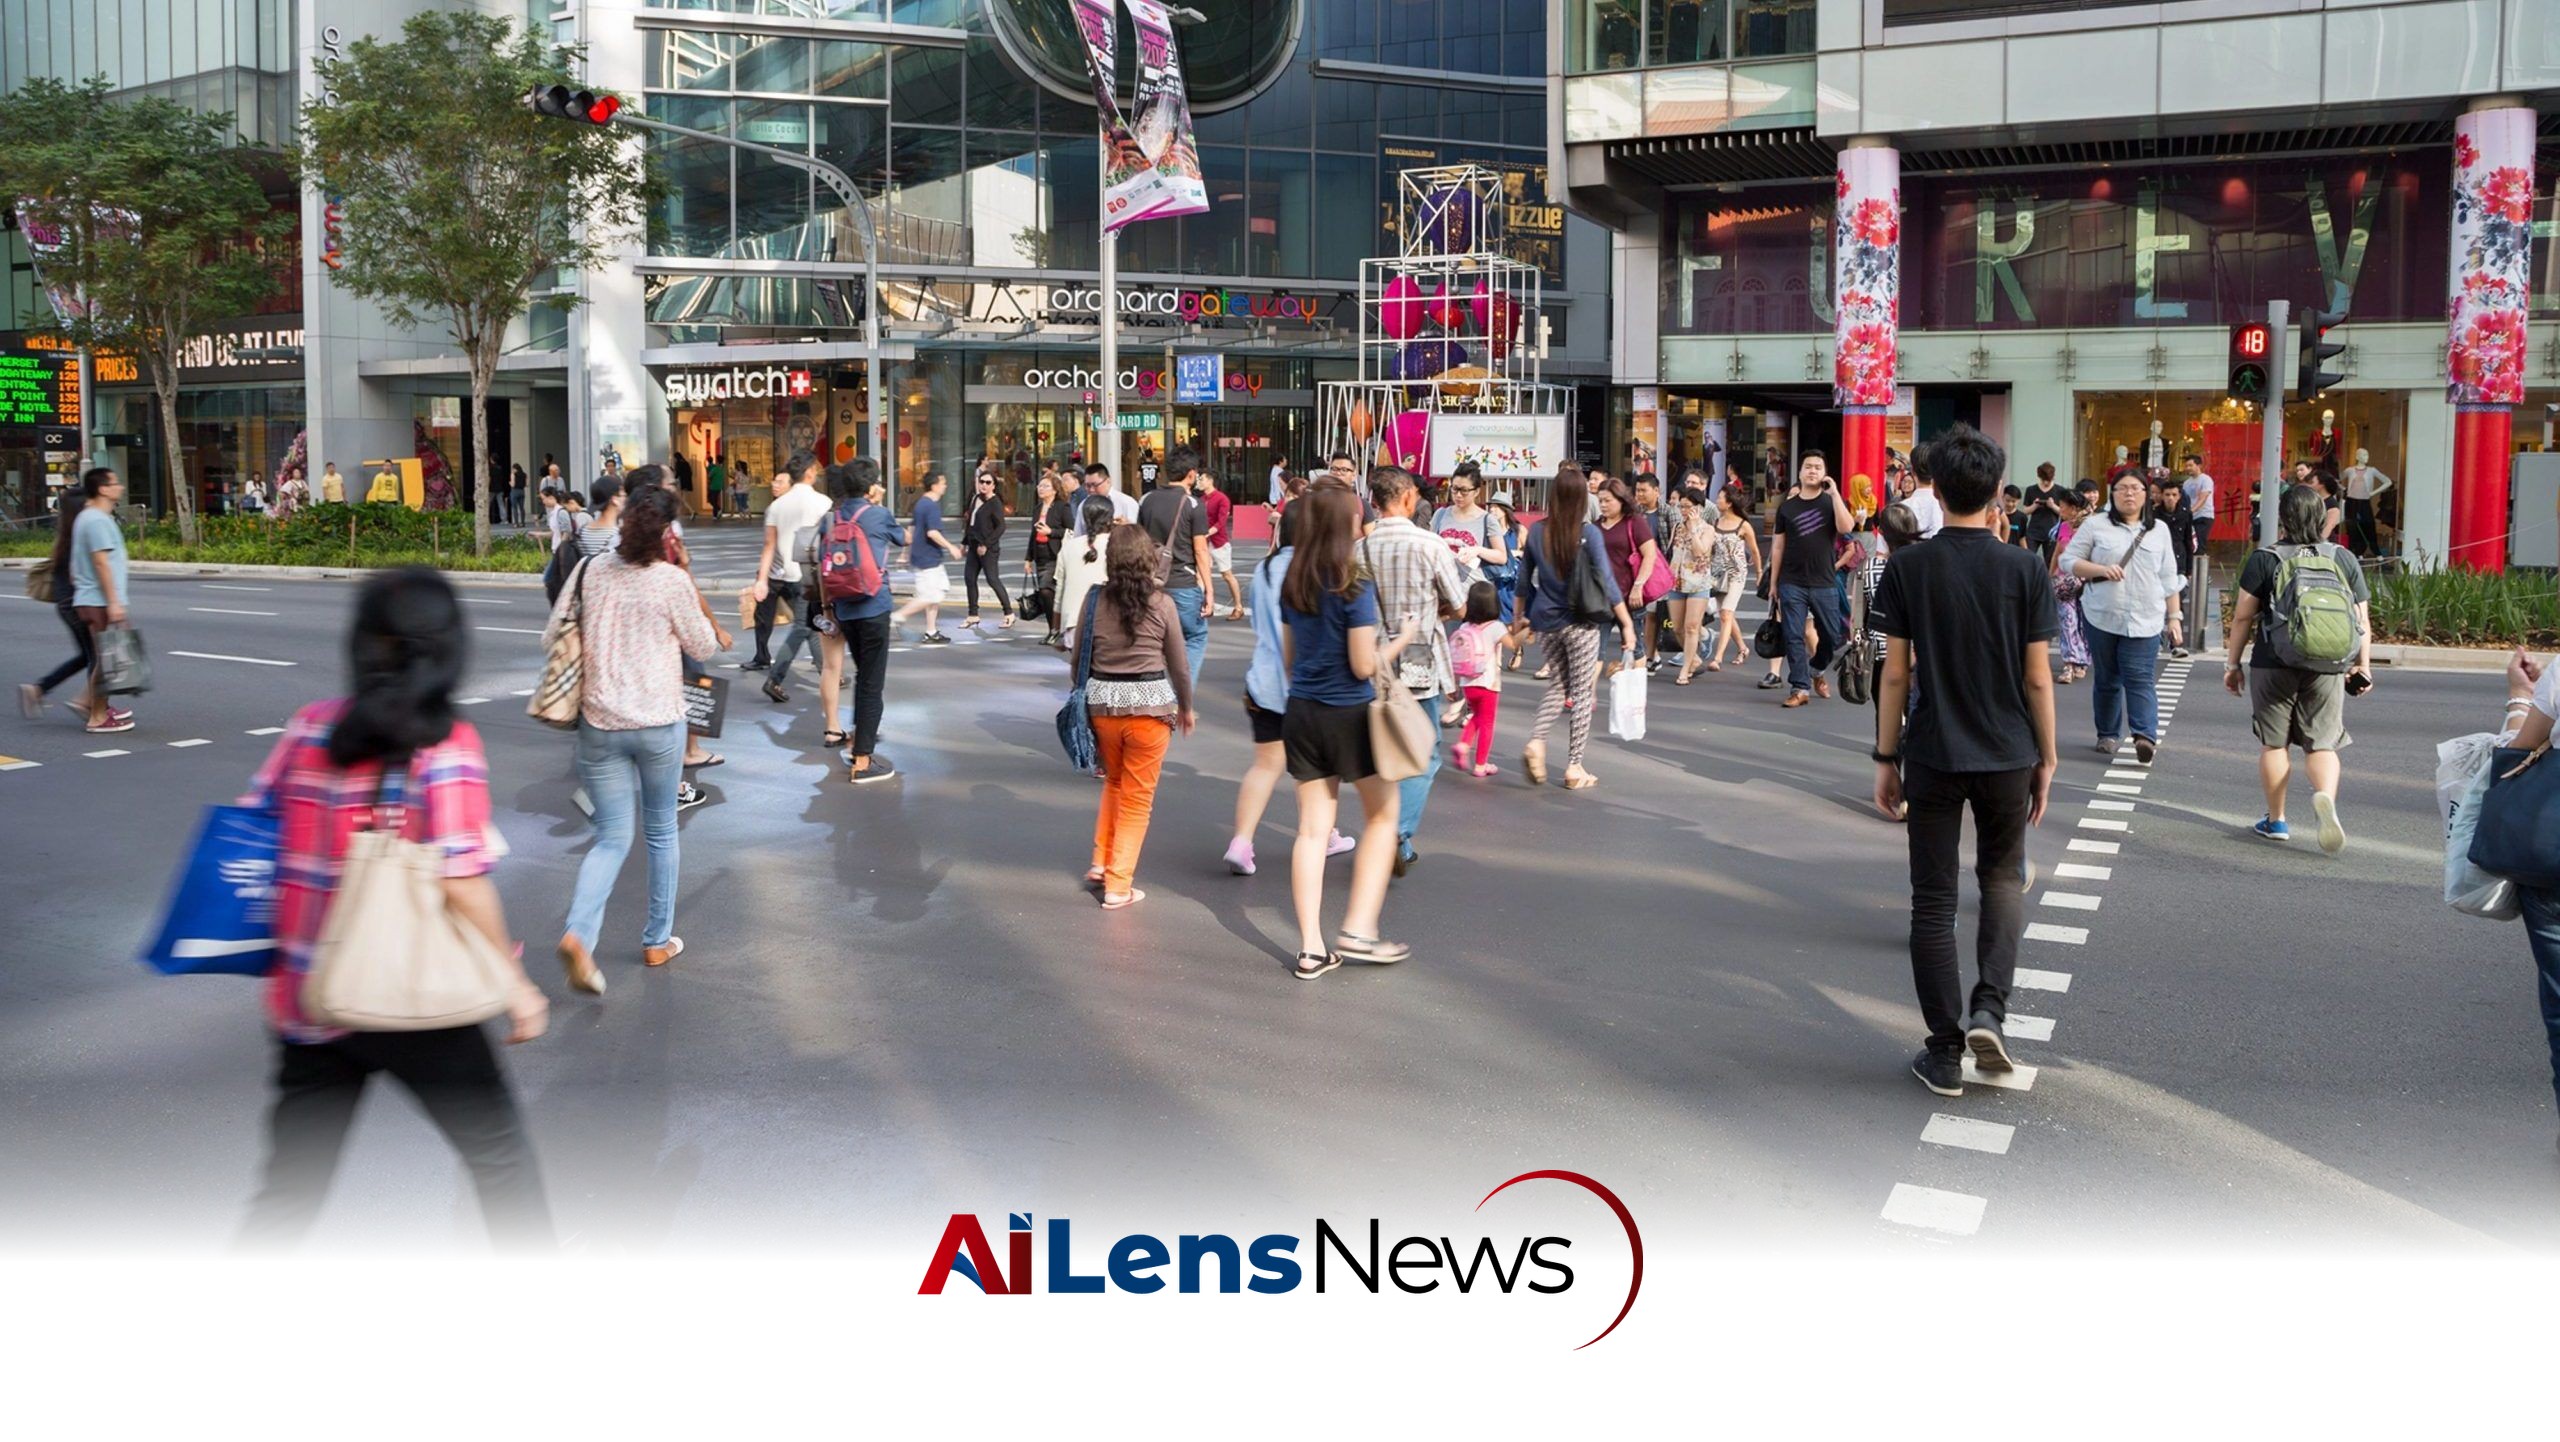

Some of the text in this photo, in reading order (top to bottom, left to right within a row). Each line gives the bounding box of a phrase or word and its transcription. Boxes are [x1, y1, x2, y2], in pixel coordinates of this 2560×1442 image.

[1509, 197, 1563, 230] izzue
[2245, 330, 2265, 353] 18
[665, 365, 787, 401] swatch
[12, 390, 48, 402] POINT
[19, 402, 54, 413] HOTEL
[1095, 414, 1157, 429] OARD RD
